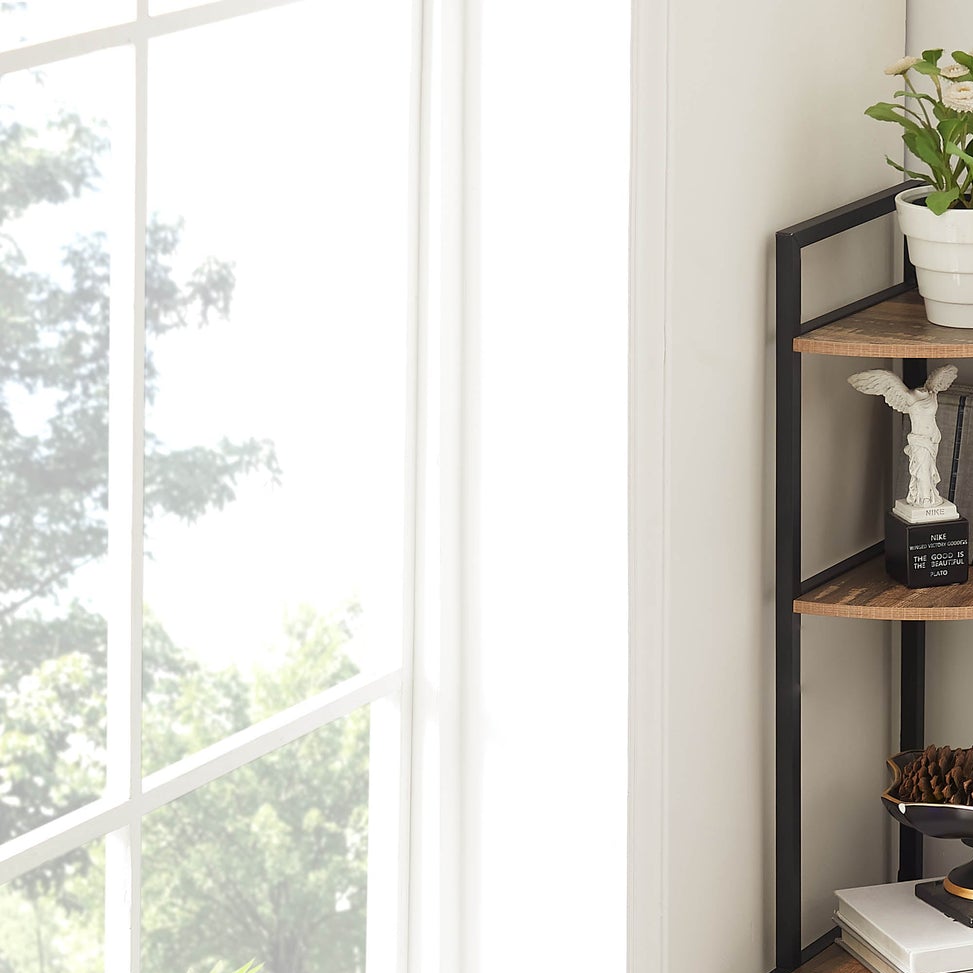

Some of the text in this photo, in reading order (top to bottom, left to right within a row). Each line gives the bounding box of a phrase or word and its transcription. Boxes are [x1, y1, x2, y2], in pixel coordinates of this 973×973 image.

[925, 508, 945, 516] NIKE
[930, 533, 947, 541] NIKE
[931, 559, 964, 568] BEAUTIFUL
